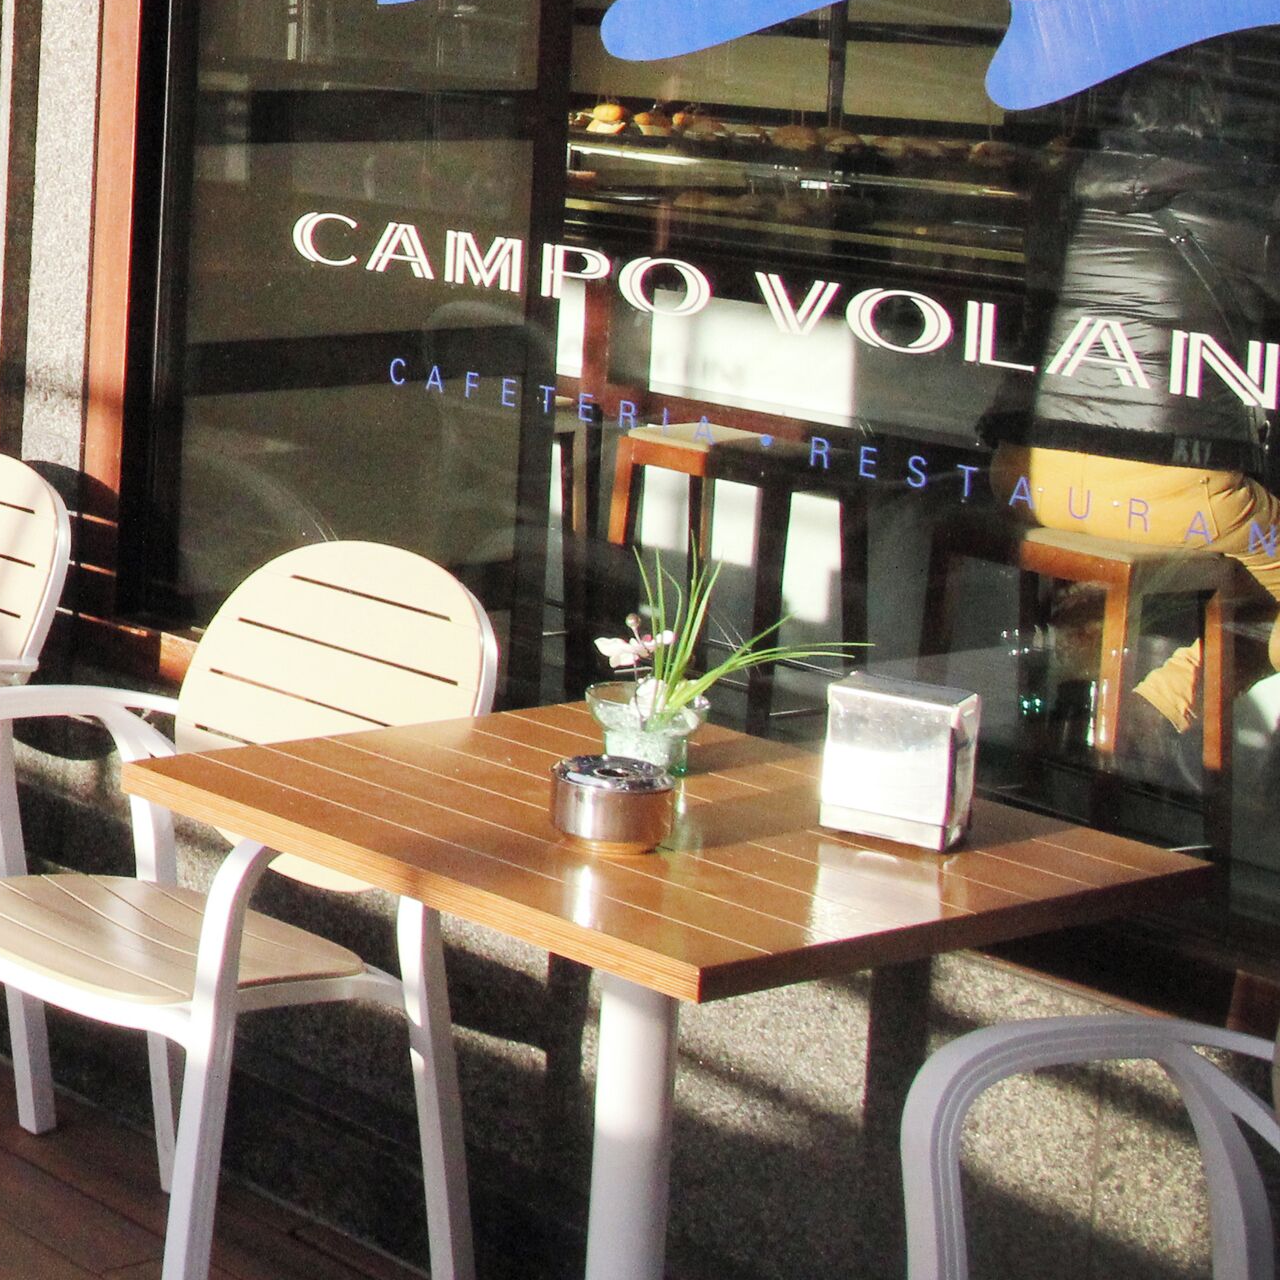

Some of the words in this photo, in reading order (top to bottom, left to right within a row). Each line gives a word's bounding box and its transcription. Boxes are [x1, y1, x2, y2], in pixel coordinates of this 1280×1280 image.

[292, 211, 712, 317] CAMPO
[754, 271, 1279, 410] VOLAN
[389, 357, 715, 446] CAFETERIA
[809, 436, 1278, 558] RESTAURAN
